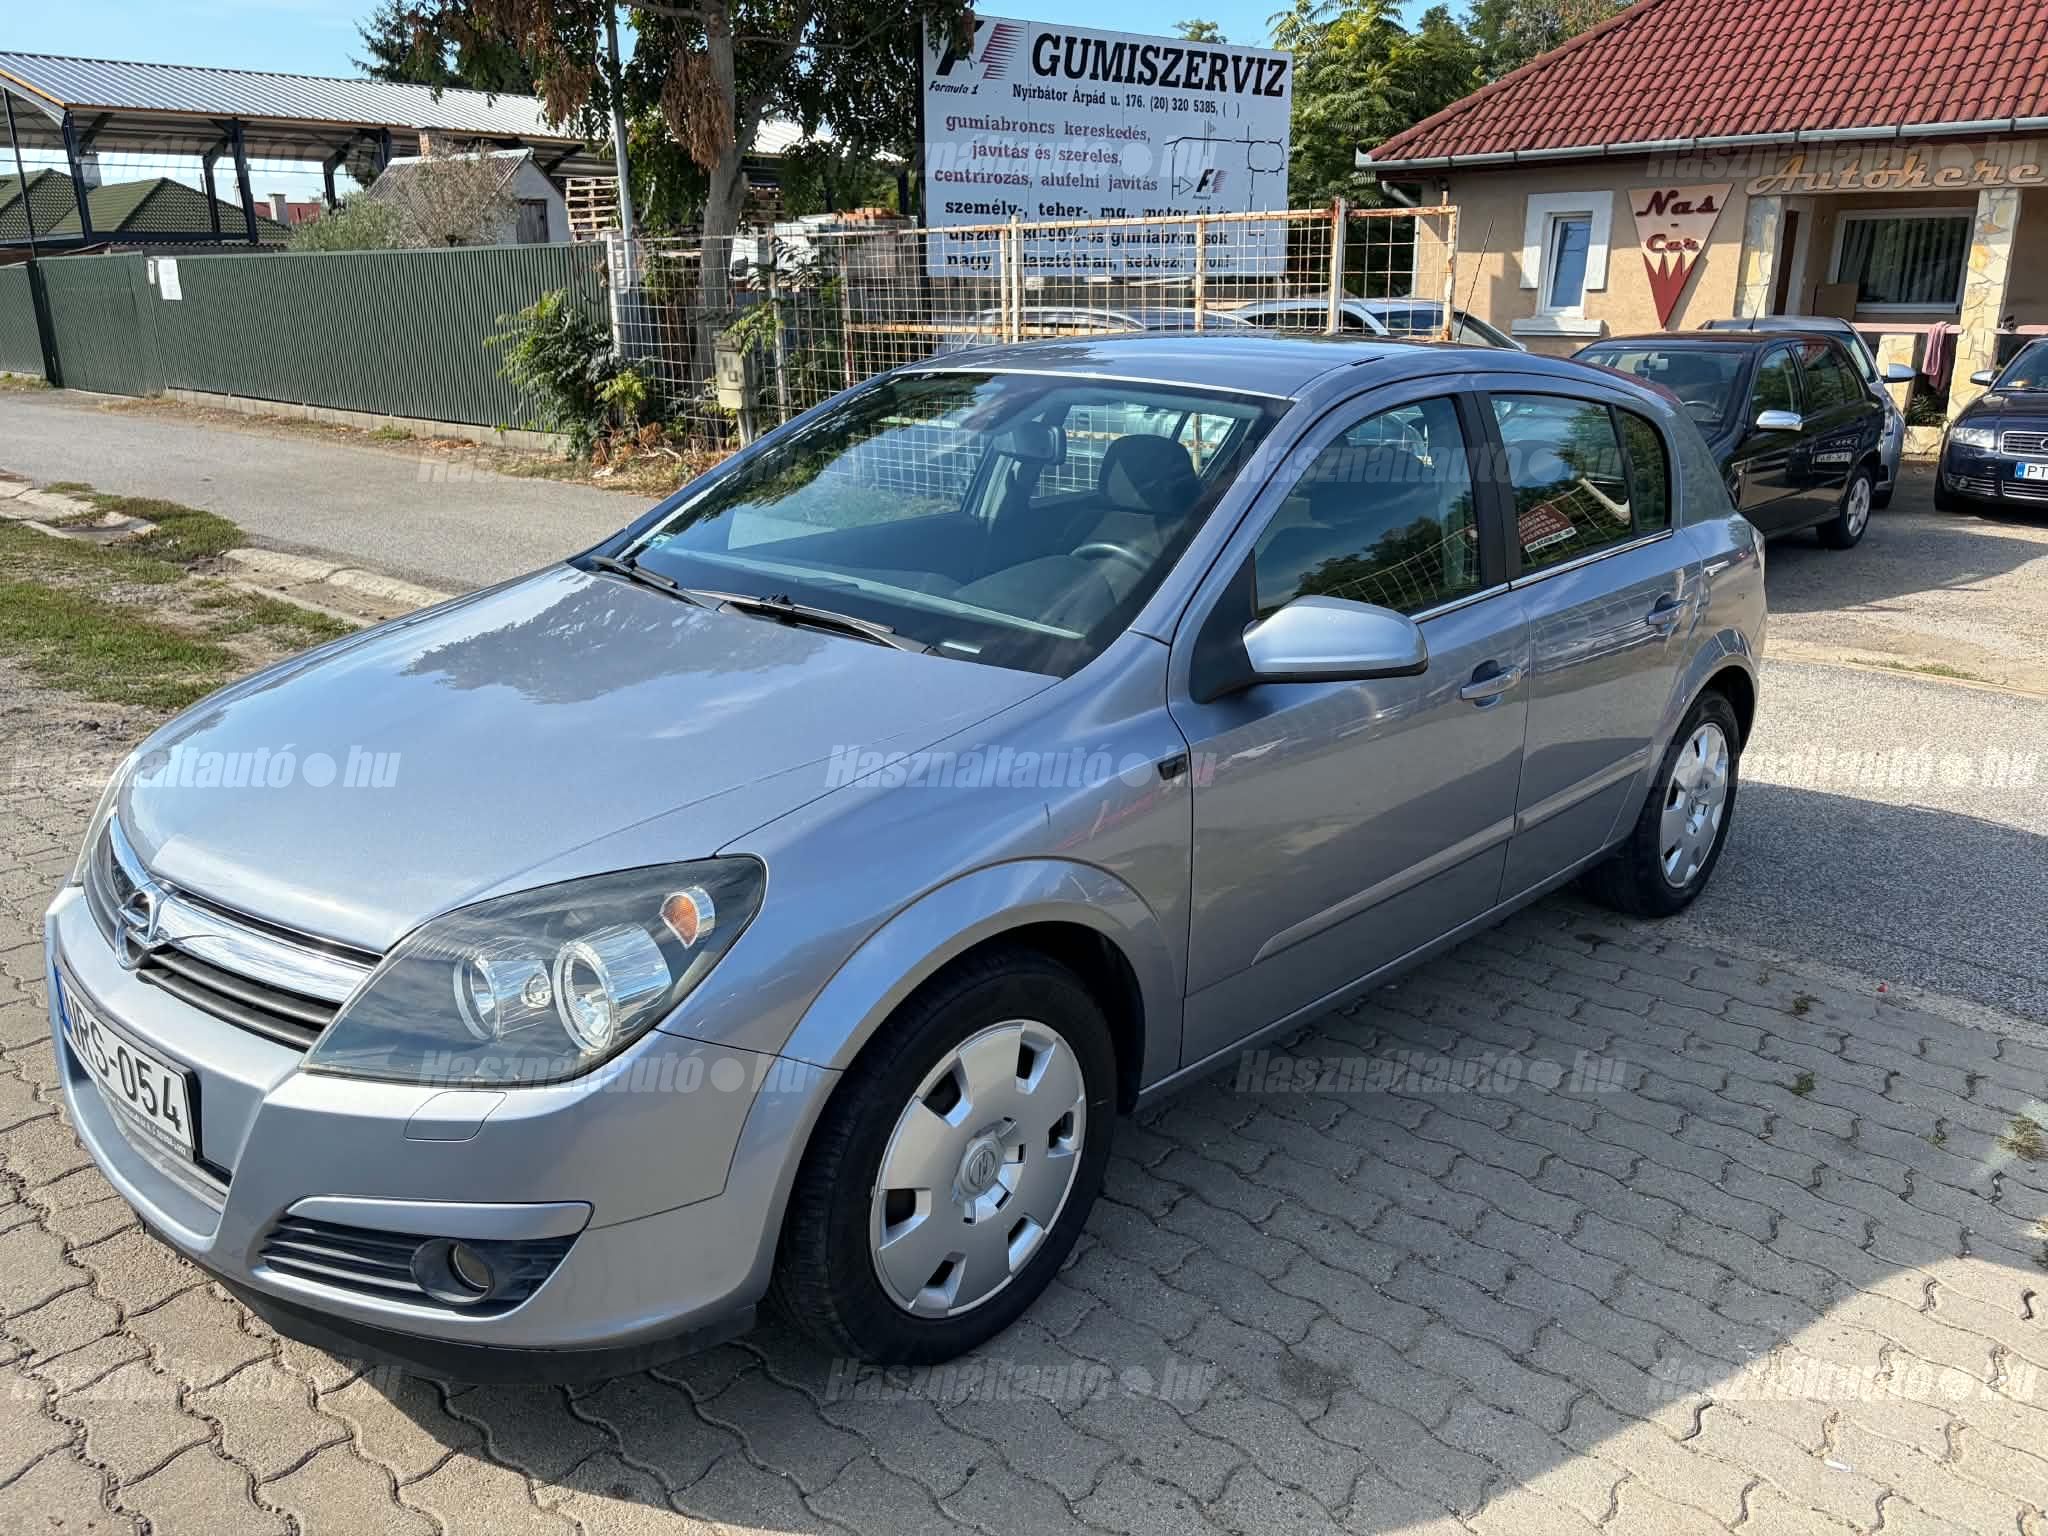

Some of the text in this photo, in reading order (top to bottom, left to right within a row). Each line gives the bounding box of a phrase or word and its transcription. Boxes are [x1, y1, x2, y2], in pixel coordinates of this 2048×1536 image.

[1032, 32, 1288, 98] GUMISZERVIZ
[929, 80, 979, 95] Formula 1
[1072, 84, 1106, 107] Árpád
[1111, 95, 1121, 106] u.
[1126, 93, 1145, 109] 176.
[1150, 96, 1169, 113] (20)
[1172, 97, 1189, 112] 320
[946, 114, 1151, 143] gumiabroncs kereskedés,
[1035, 144, 1051, 160] és
[1041, 172, 1100, 189] alufelni
[1635, 190, 1720, 217] Nas
[1645, 233, 1701, 254] Car
[947, 255, 992, 271] nagy
